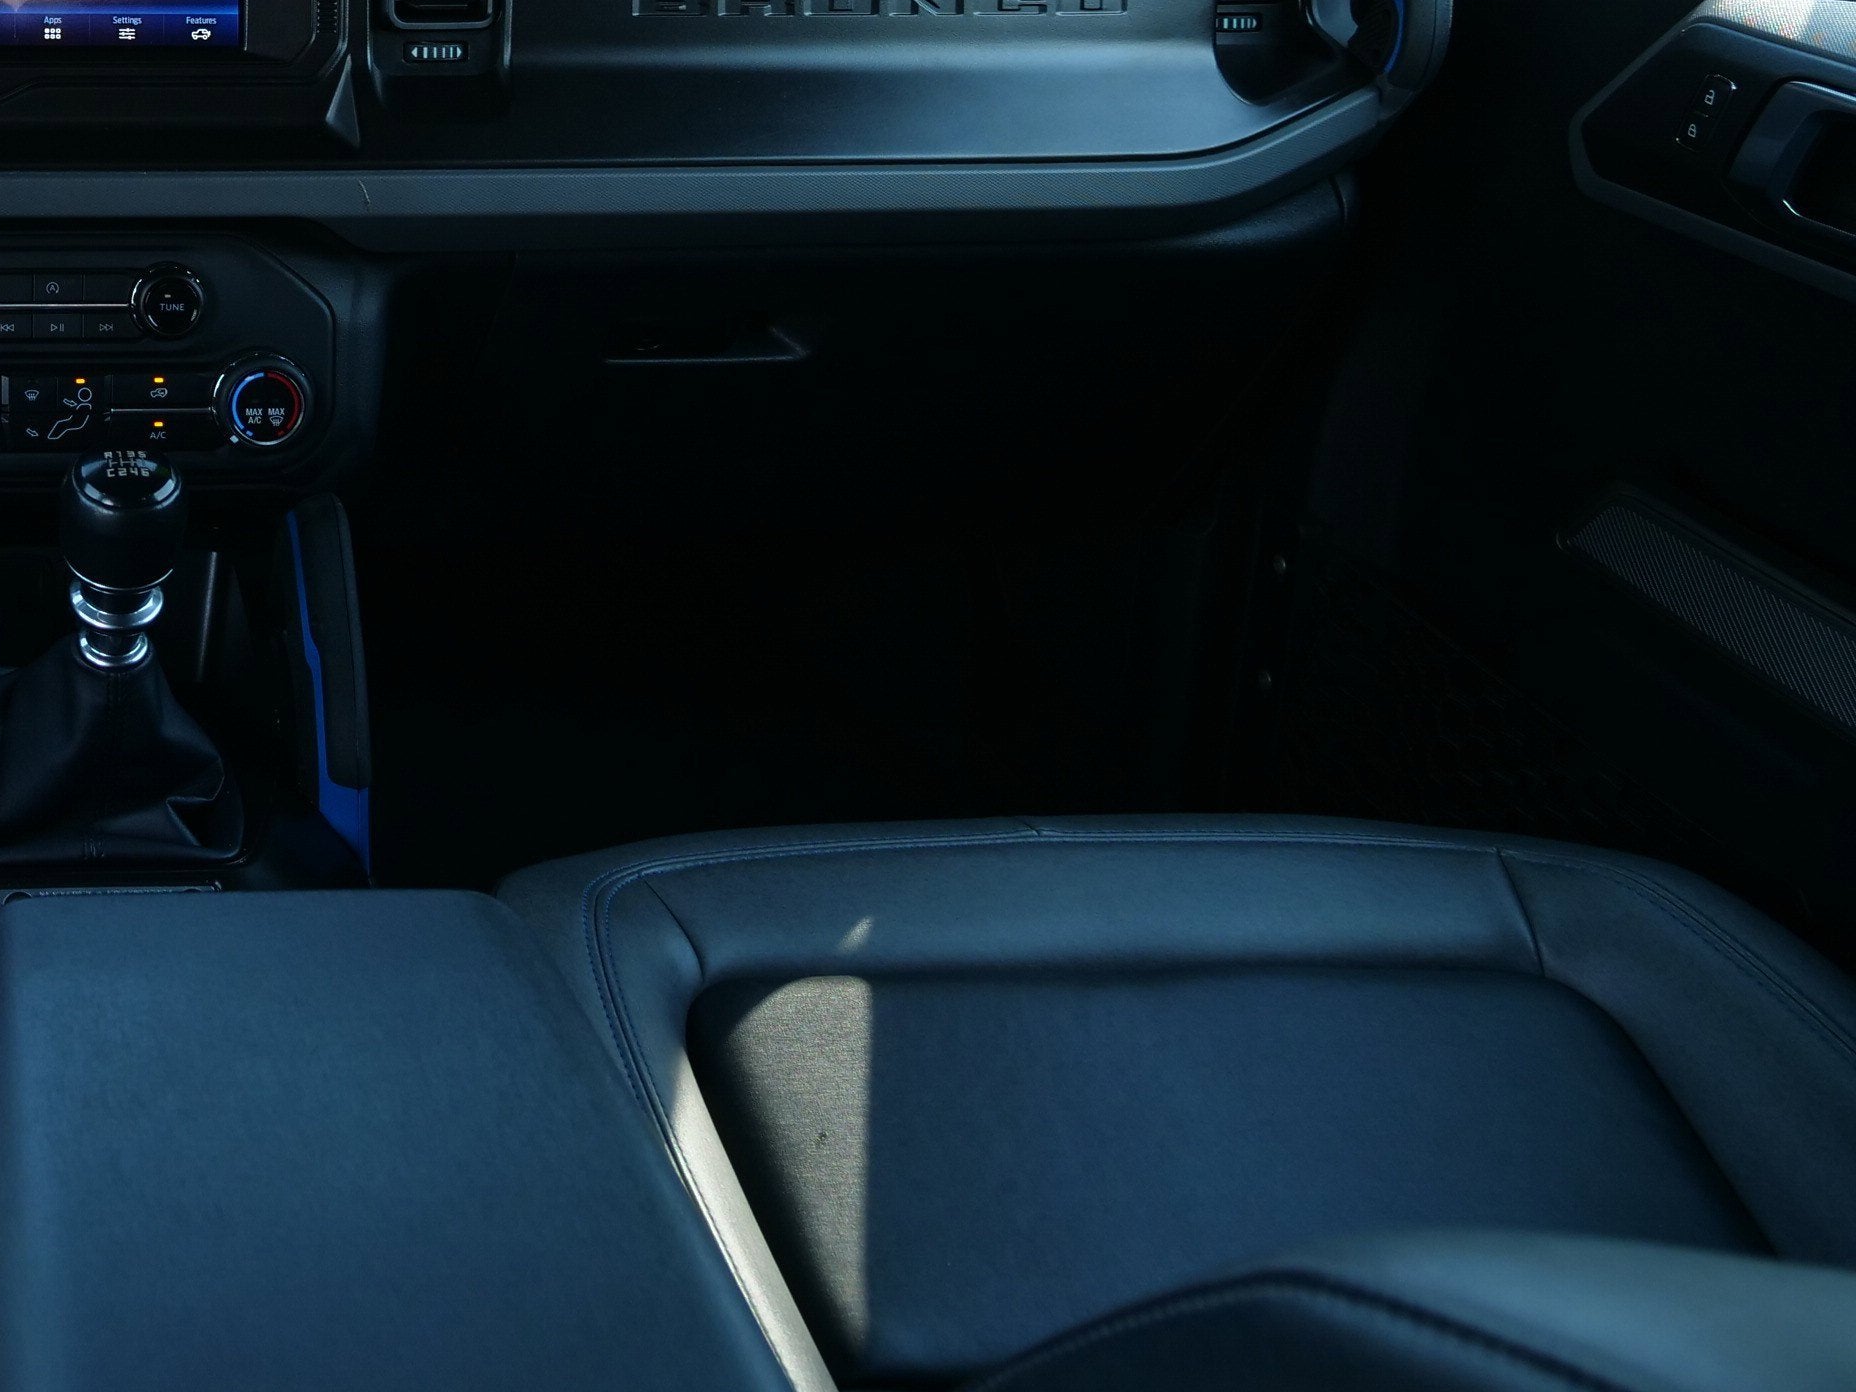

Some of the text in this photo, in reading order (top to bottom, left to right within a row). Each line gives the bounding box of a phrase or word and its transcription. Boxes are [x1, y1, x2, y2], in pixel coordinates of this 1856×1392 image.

[43, 16, 62, 27] Apps
[112, 16, 142, 27] Settings
[186, 16, 217, 25] Features
[160, 303, 185, 311] TUNE
[245, 408, 262, 416] MAX
[267, 408, 285, 416] MAX
[247, 415, 262, 424] A/C
[149, 430, 167, 440] A/C
